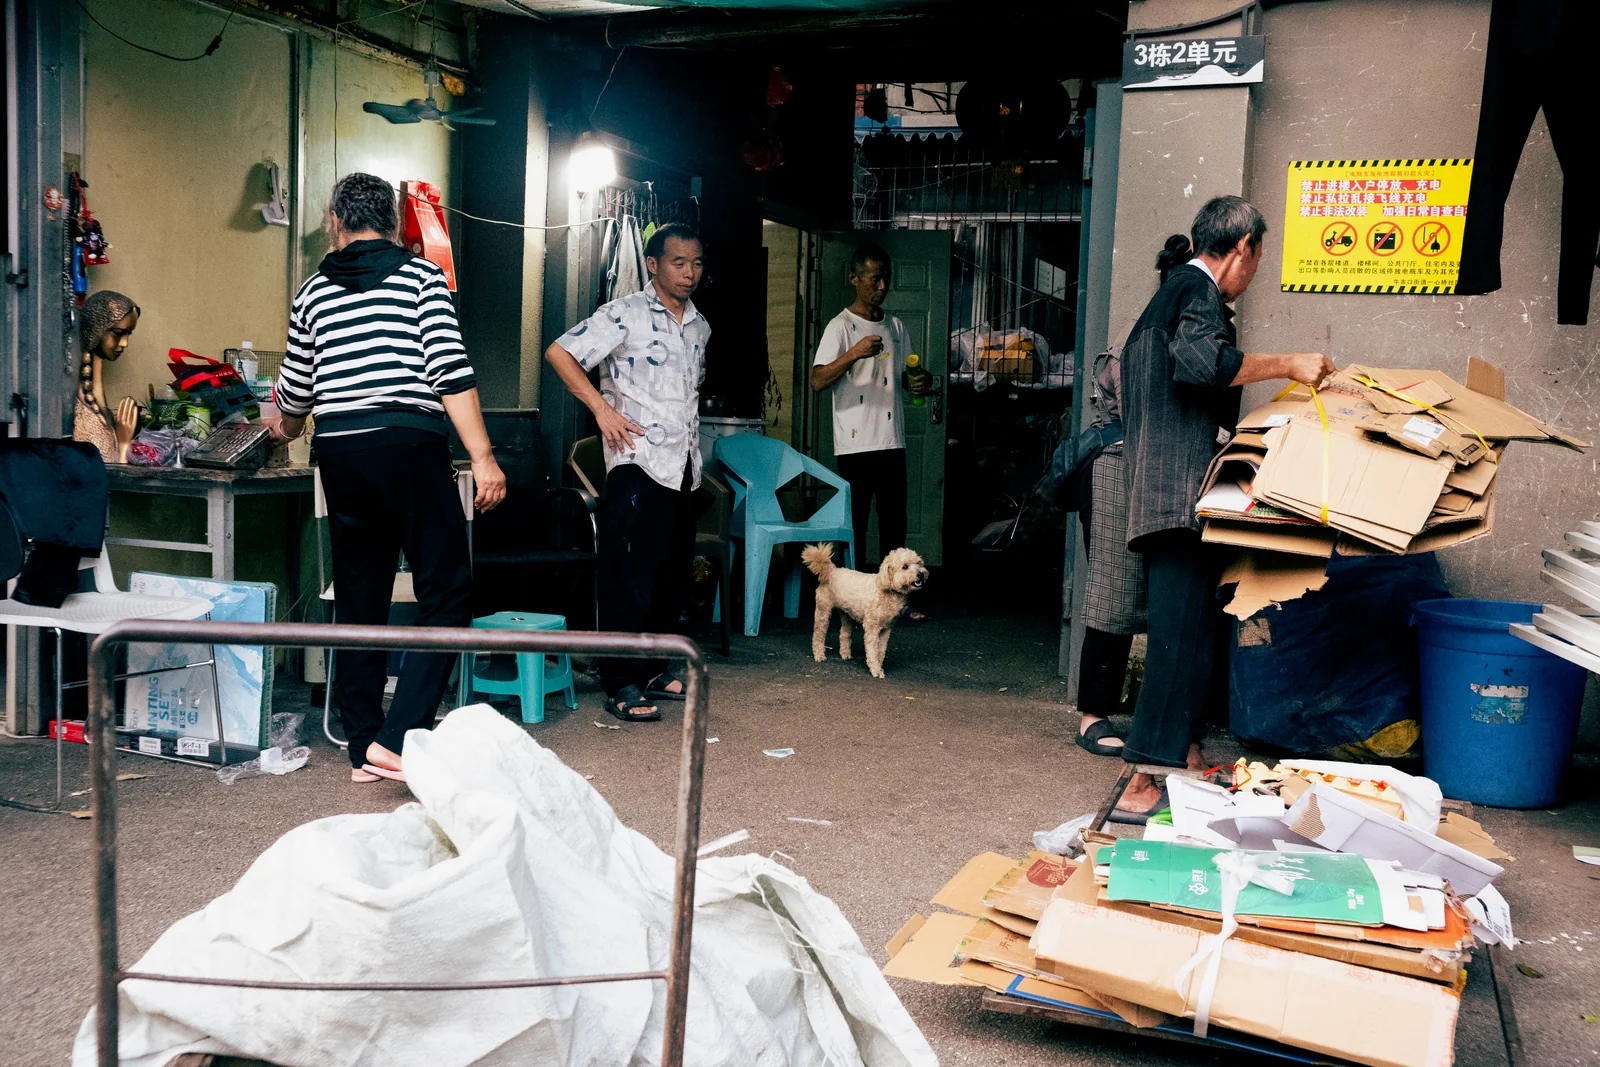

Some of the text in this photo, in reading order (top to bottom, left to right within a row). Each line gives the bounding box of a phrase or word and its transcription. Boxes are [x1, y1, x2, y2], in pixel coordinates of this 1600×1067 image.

[1134, 40, 1237, 67] 3栋2单元
[1301, 180, 1441, 192] 禁止进楼入户停放、充电
[1301, 192, 1427, 204] 禁止私拉乱接飞线充电
[1300, 205, 1468, 217] 禁止非法改装 加强日常自查自
[147, 675, 159, 732] INTING
[159, 688, 170, 721] SET
